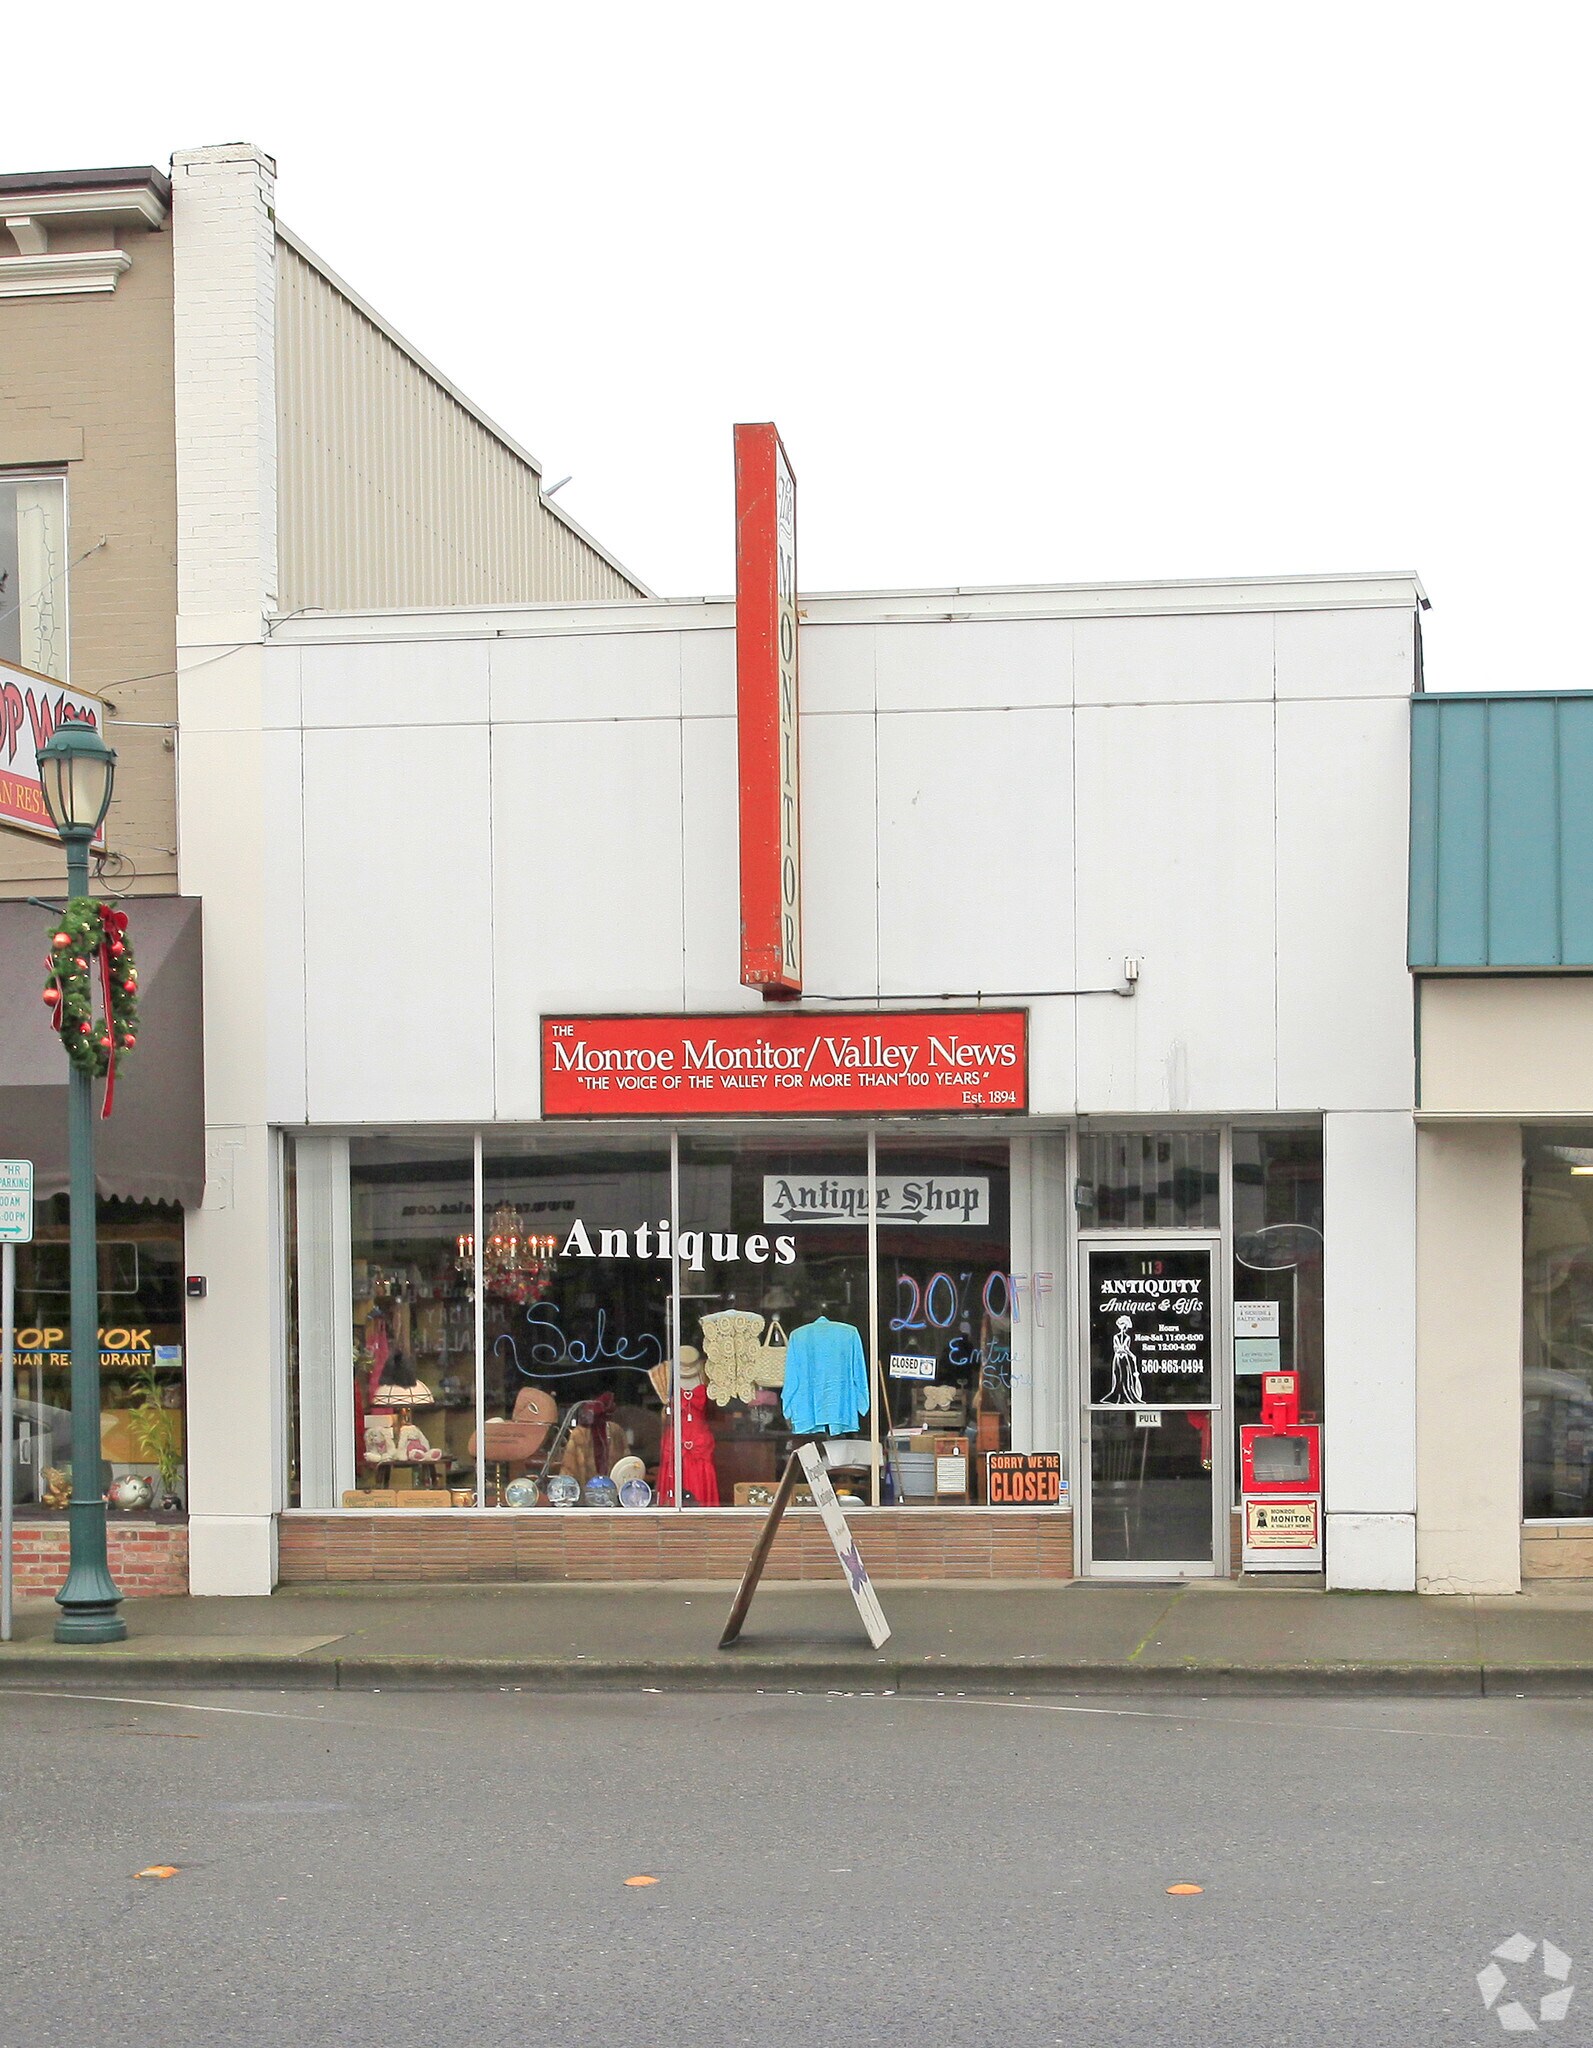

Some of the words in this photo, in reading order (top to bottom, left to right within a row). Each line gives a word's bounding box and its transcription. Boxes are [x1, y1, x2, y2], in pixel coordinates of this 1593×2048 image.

[777, 544, 798, 970] MONITOR
[552, 1024, 574, 1036] THE
[552, 1042, 674, 1072] Monroe
[927, 1036, 1016, 1068] News
[616, 1075, 657, 1090] VOICE
[662, 1075, 682, 1089] OF
[688, 1075, 714, 1089] THE
[719, 1074, 768, 1089] VALLEY
[774, 1074, 804, 1088] FOR
[809, 1073, 852, 1087] MORE
[858, 1073, 899, 1086] THAN
[905, 1072, 929, 1086] 100
[962, 1090, 986, 1104] Est.
[988, 1090, 1017, 1104] 1894
[7, 1165, 21, 1175] HR
[771, 1179, 891, 1217] Antique
[901, 1179, 980, 1223] Shop
[559, 1218, 797, 1272] Antiques
[1141, 1261, 1163, 1275] 113
[1100, 1279, 1202, 1297] ANTIQUITY
[982, 1271, 1054, 1328] OFF
[1099, 1297, 1157, 1314] Antiques
[1158, 1298, 1171, 1312] &
[1172, 1297, 1204, 1315] Gifts
[526, 1301, 648, 1365] Sale
[1158, 1324, 1180, 1332] Hours
[97, 1328, 152, 1351] OK
[1142, 1343, 1156, 1351] Sun
[0, 1353, 43, 1366] SIAN
[50, 1353, 152, 1366] REURANT
[892, 1357, 919, 1370] CLOSED
[1139, 1414, 1158, 1423] PULL
[991, 1456, 1024, 1469] SORRY
[1028, 1455, 1059, 1469] WE'RE
[991, 1471, 1059, 1503] CLOSED
[1271, 1515, 1311, 1523] MONITOR
